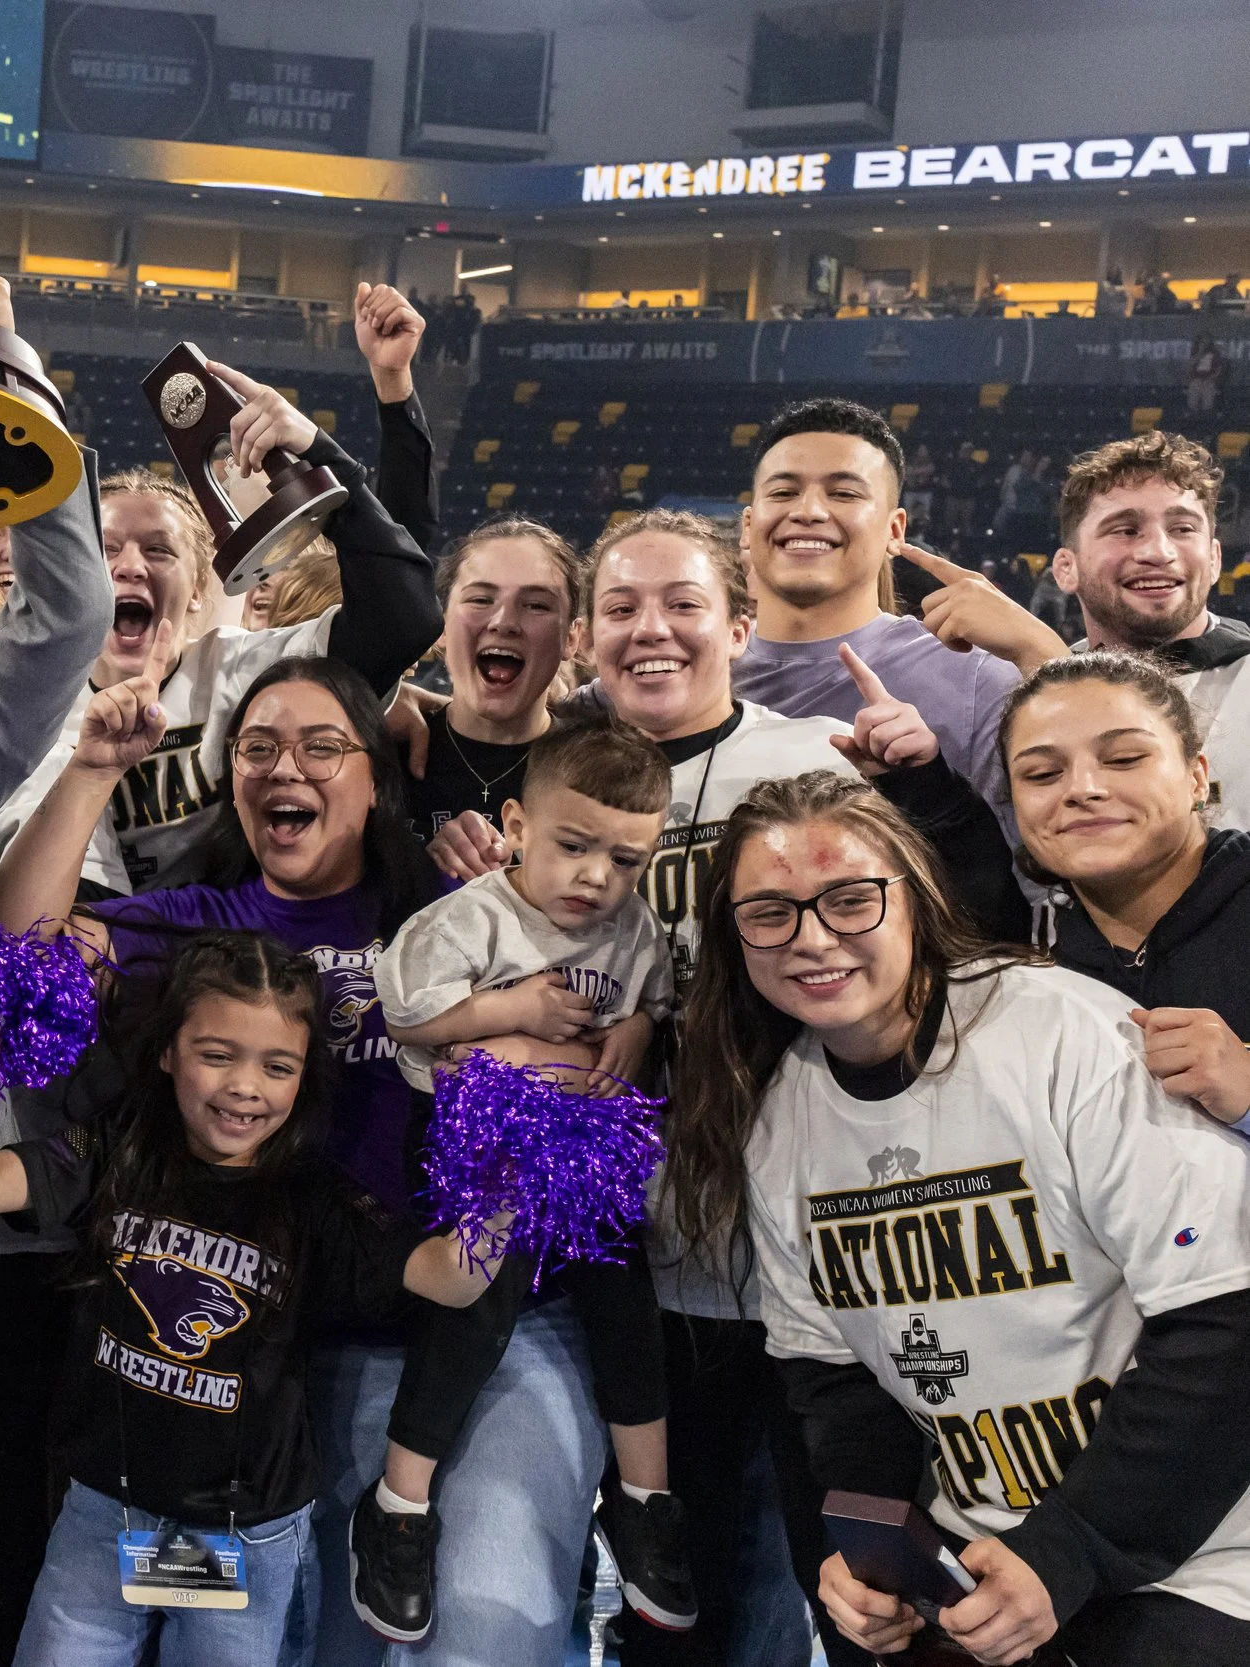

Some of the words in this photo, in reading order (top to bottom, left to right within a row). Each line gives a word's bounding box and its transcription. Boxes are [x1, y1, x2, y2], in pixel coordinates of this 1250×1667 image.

[272, 62, 314, 84] THE
[228, 81, 355, 111] SPOTLIGHT
[246, 106, 333, 132] AWAITS
[582, 154, 828, 202] MCKENDREE
[853, 132, 1250, 188] BEARCAT
[530, 342, 635, 360] SPOTLIGHT
[641, 341, 717, 360] AWAITS
[170, 384, 206, 423] NCAA
[839, 1196, 870, 1213] NCAA
[873, 1186, 924, 1209] WOMEN'S
[907, 1351, 940, 1360] WRESTLING
[96, 1331, 238, 1408] WRESTLING
[122, 1544, 159, 1553] Championship
[158, 1563, 208, 1573] #NCAAWrestling
[172, 1591, 199, 1603] VIP
